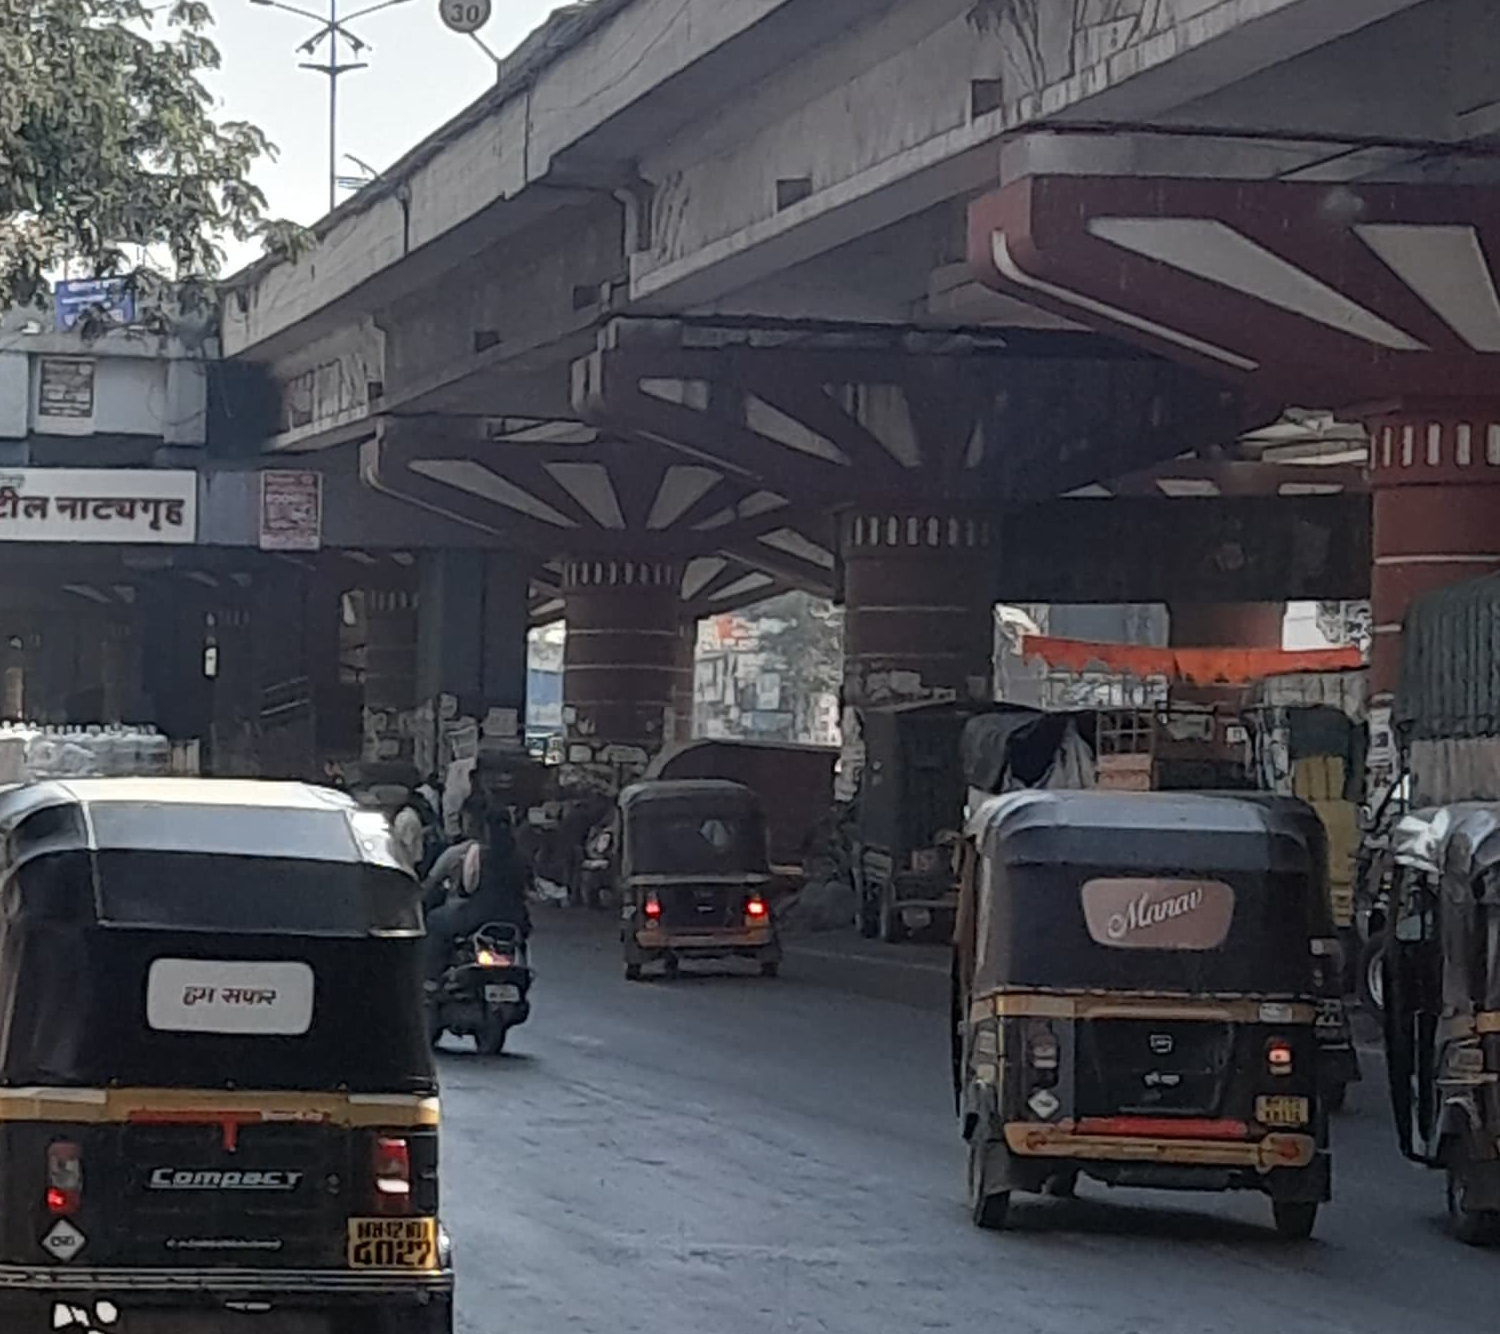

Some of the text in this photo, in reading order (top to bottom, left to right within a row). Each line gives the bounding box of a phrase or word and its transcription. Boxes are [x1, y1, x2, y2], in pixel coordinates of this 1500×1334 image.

[55, 496, 185, 530] नाट्यगृह
[1107, 887, 1203, 939] Manav
[222, 987, 277, 1006] सफर
